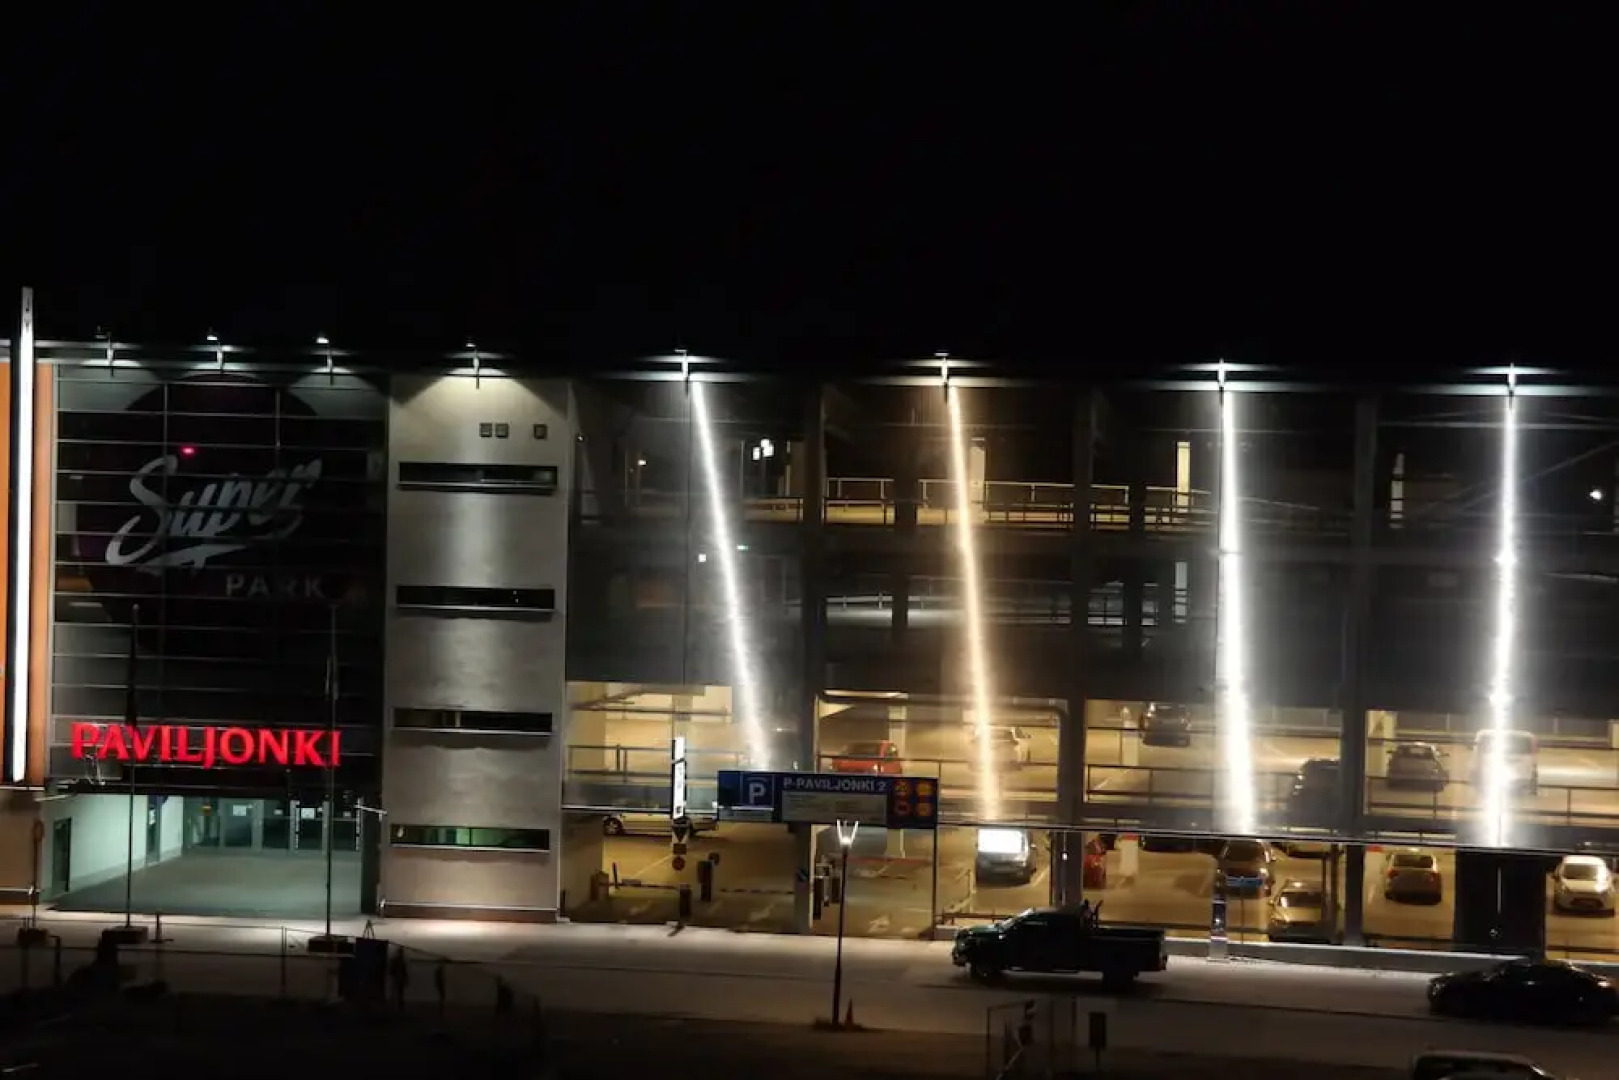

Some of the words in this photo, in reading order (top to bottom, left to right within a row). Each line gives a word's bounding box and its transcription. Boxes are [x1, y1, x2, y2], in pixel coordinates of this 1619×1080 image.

[105, 454, 322, 572] Super
[226, 574, 325, 600] PARK
[72, 723, 341, 769] PAVILJONKI
[749, 782, 765, 804] P
